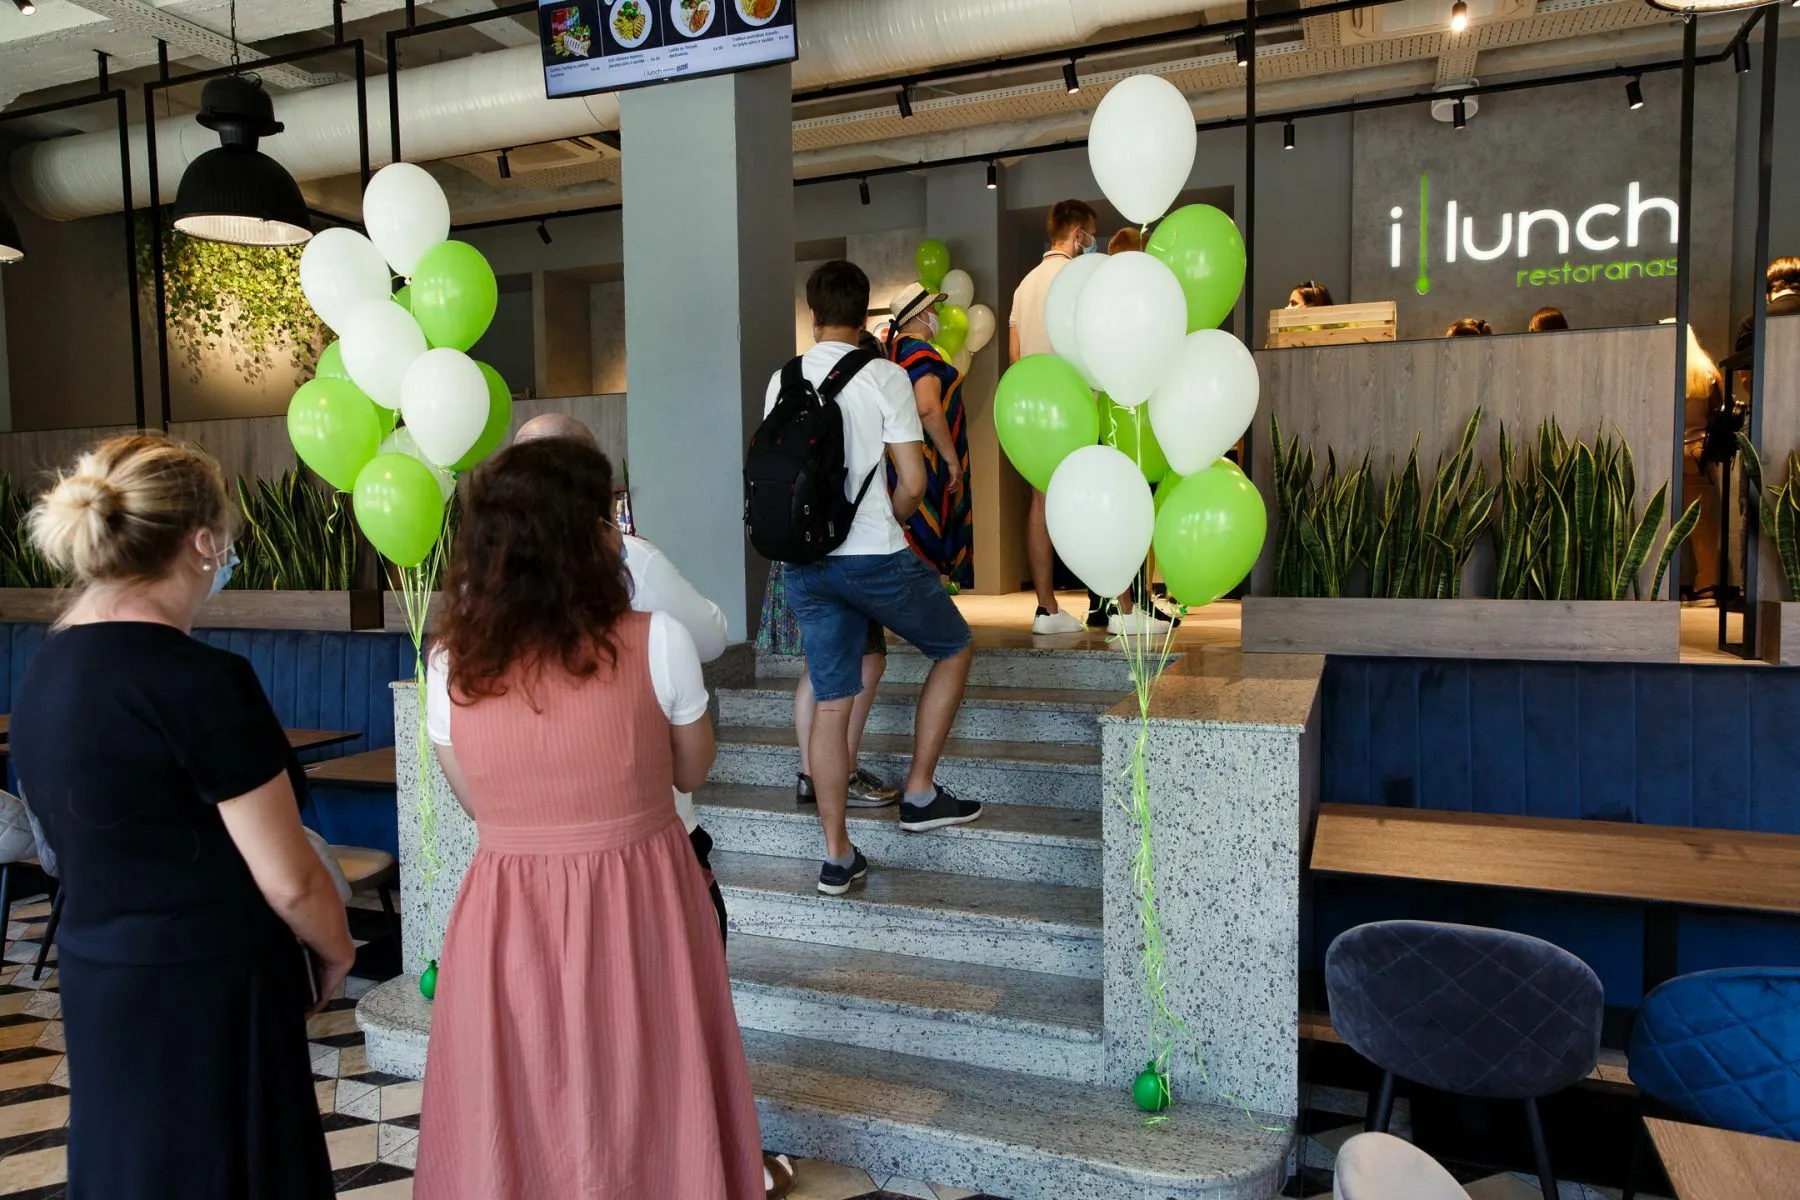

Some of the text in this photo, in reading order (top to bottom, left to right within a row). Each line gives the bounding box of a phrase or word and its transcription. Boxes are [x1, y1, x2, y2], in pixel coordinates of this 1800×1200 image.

[1390, 181, 1680, 268] i lunch
[1516, 256, 1679, 288] restoranas
